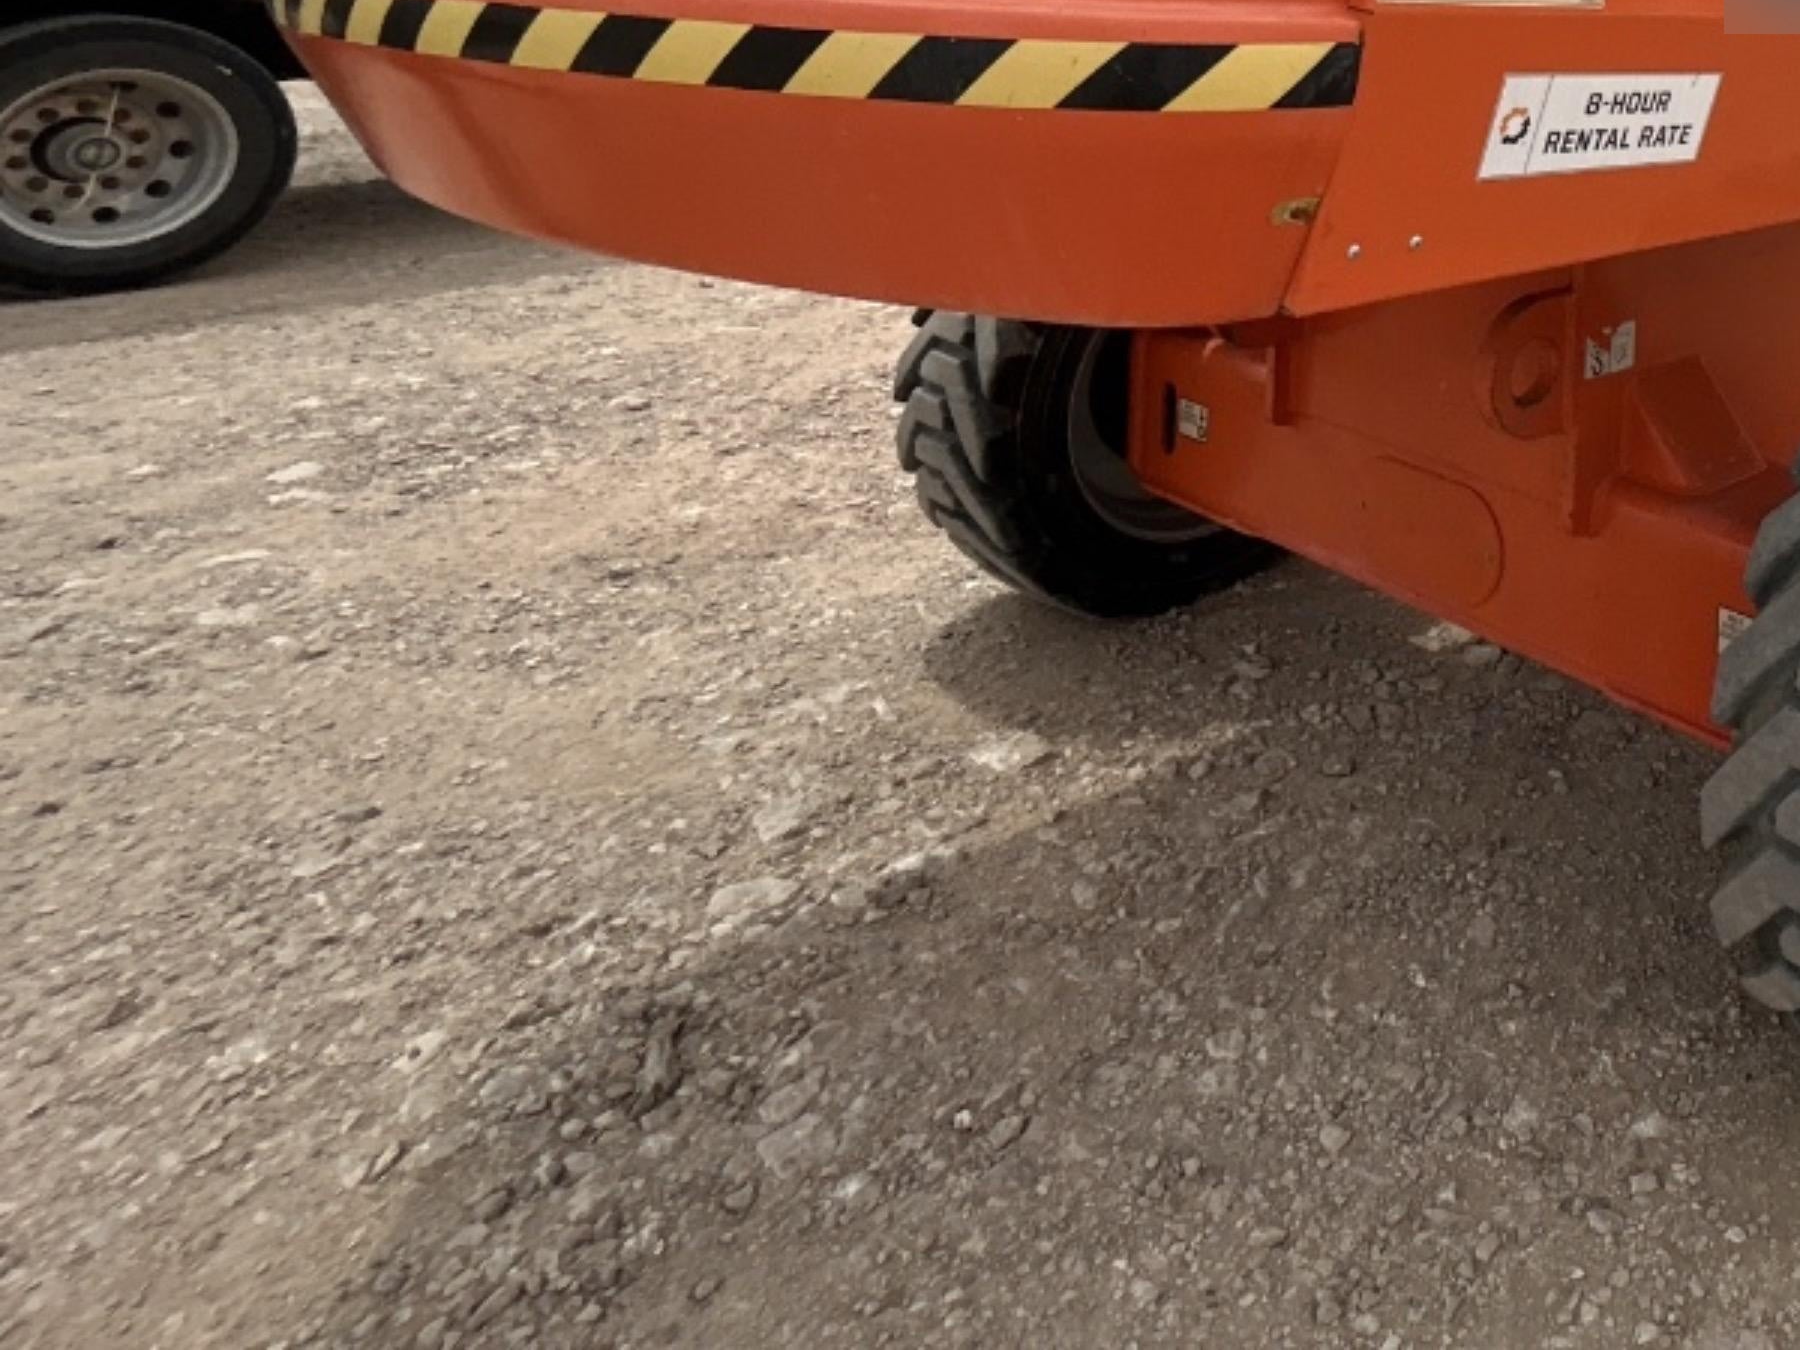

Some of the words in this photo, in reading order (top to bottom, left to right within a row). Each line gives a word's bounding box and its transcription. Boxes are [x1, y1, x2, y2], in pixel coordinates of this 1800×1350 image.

[1584, 90, 1672, 115] 8-HOUR
[1542, 127, 1630, 154] RENTAL
[1637, 124, 1693, 148] RATE
